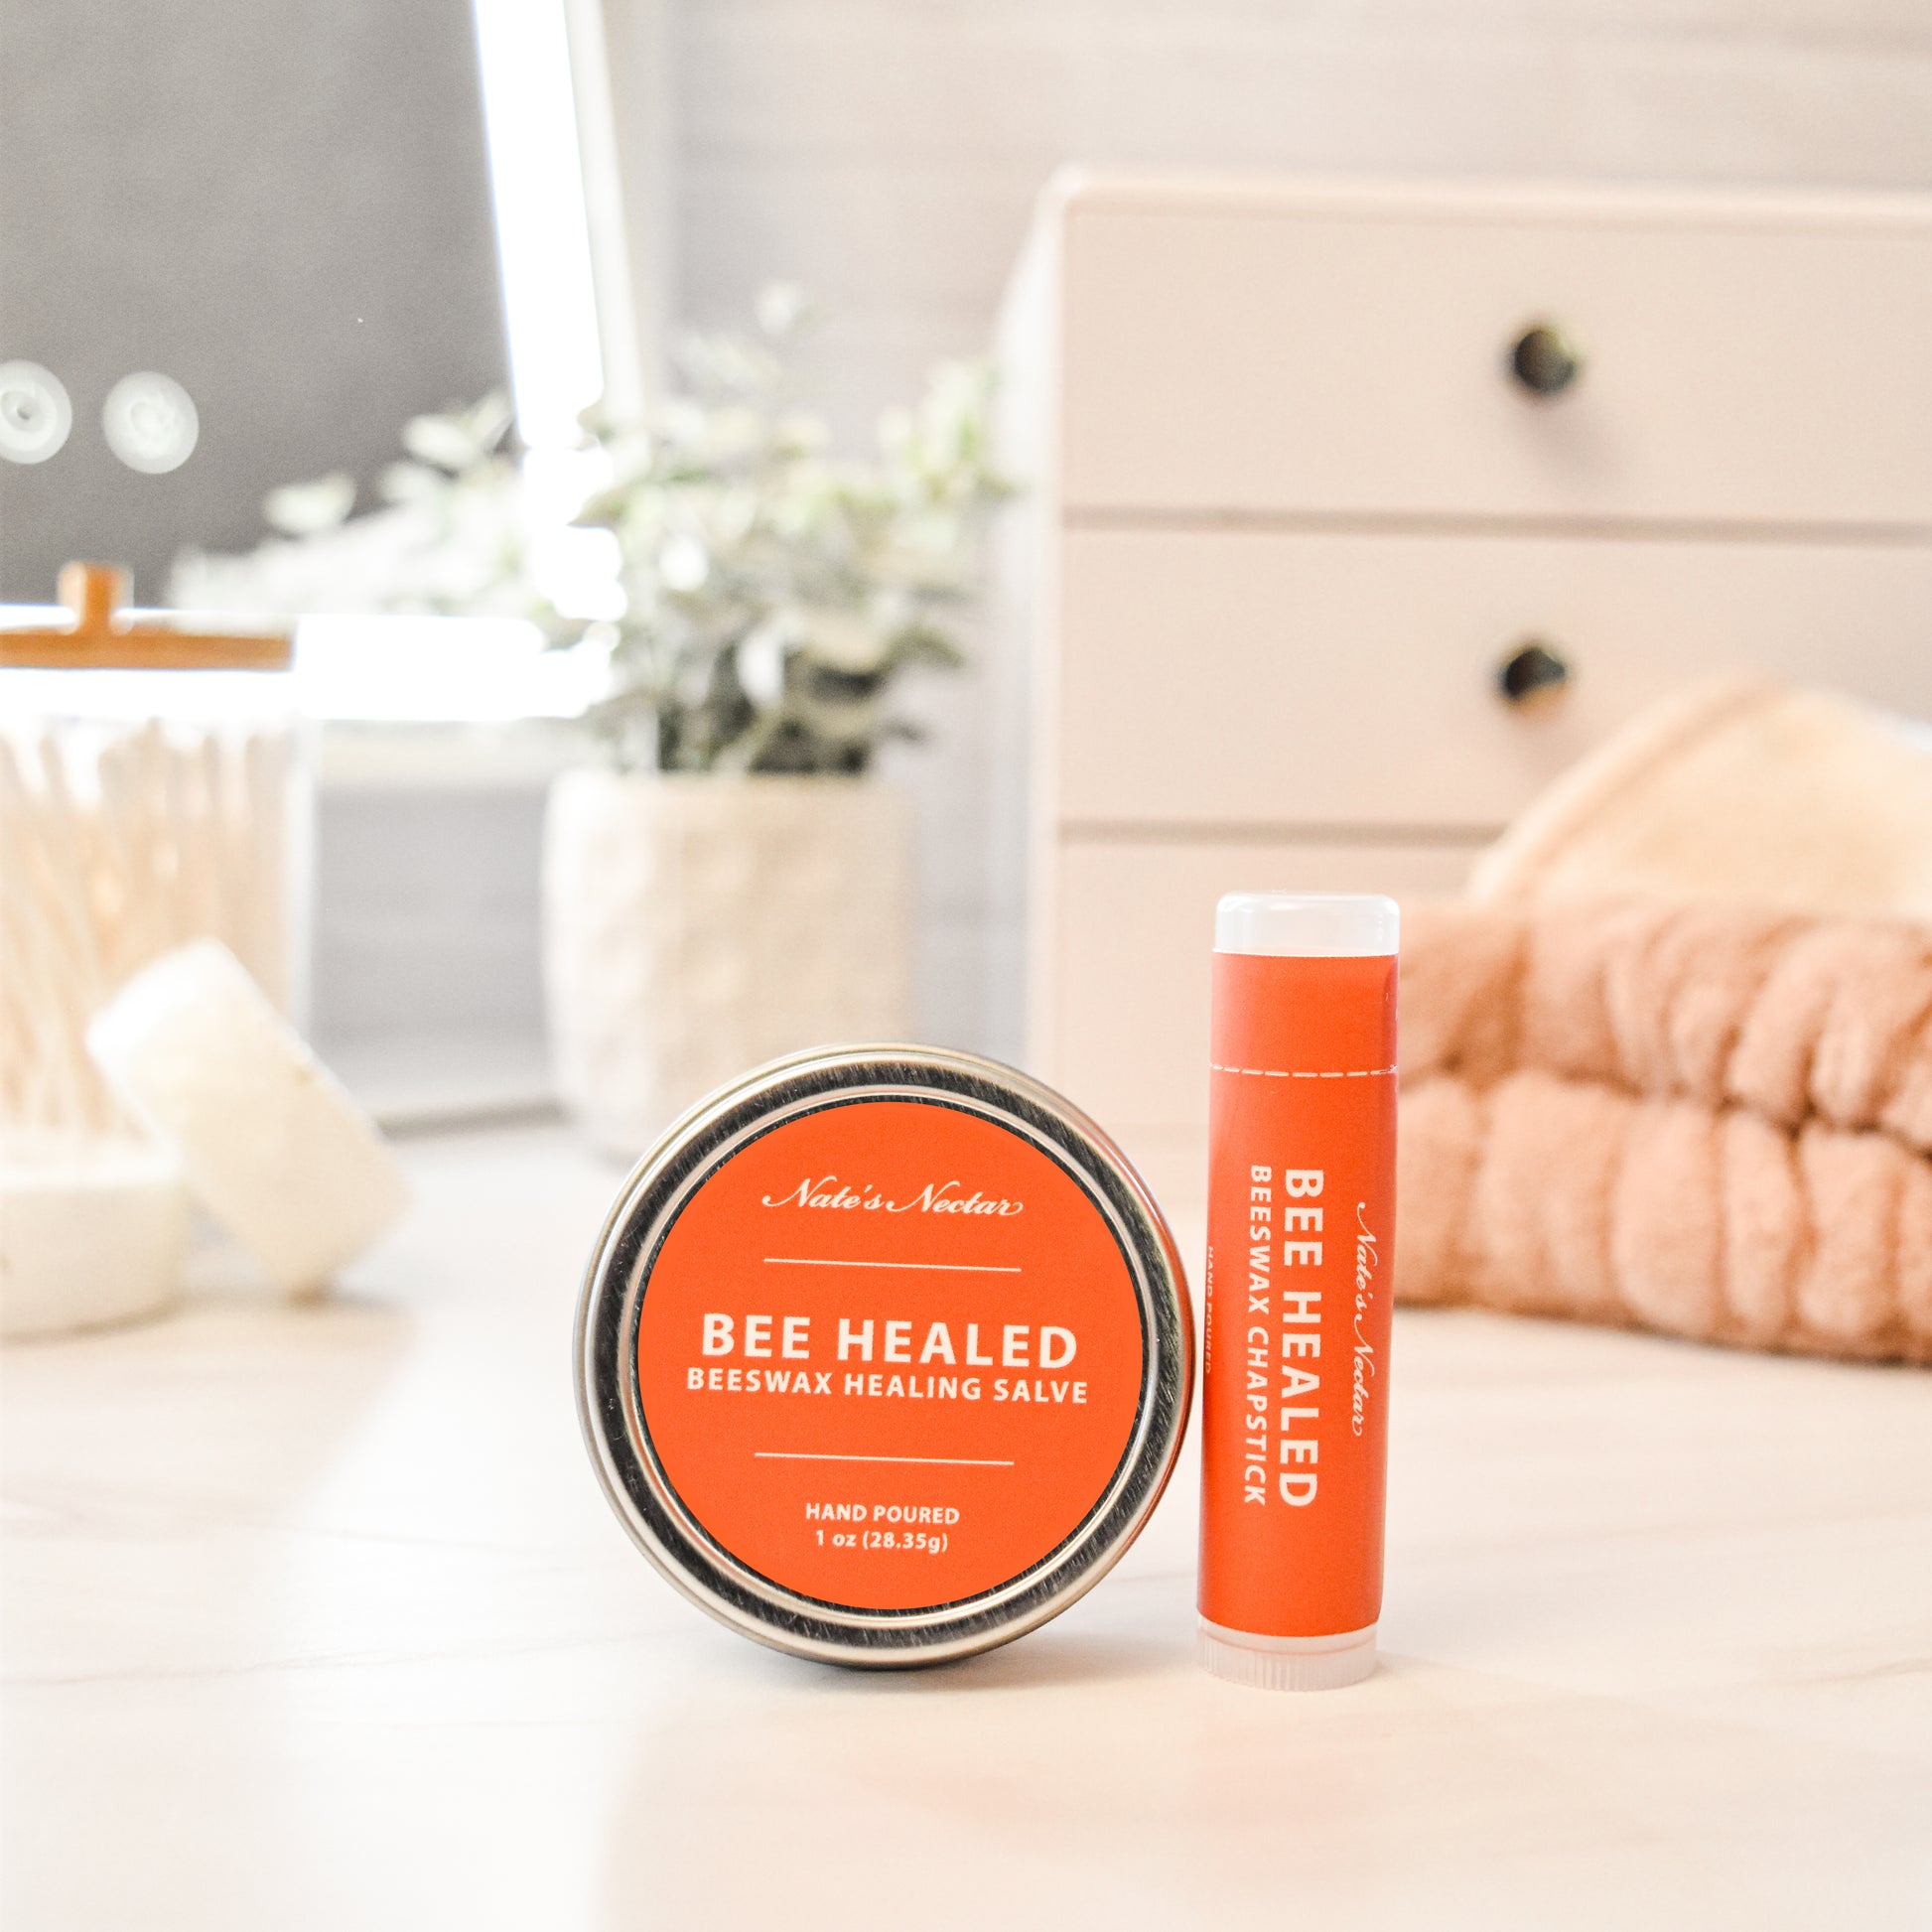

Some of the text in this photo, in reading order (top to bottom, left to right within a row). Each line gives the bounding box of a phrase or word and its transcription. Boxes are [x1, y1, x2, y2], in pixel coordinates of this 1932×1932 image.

[761, 1174, 1024, 1216] Nate's Nectar
[1204, 1245, 1214, 1375] HAND POURED
[1244, 1165, 1273, 1506] BEESWAX CHAPSTICK
[1278, 1169, 1324, 1507] BEE HEALED
[1351, 1201, 1379, 1437] Nate's Nectar
[702, 1312, 1077, 1368] BEE HEALED
[686, 1367, 1088, 1404] BEESWAX HEALING SALVE
[805, 1502, 960, 1525] HAND POURED
[815, 1529, 949, 1555] 1 oz (28.35g)
